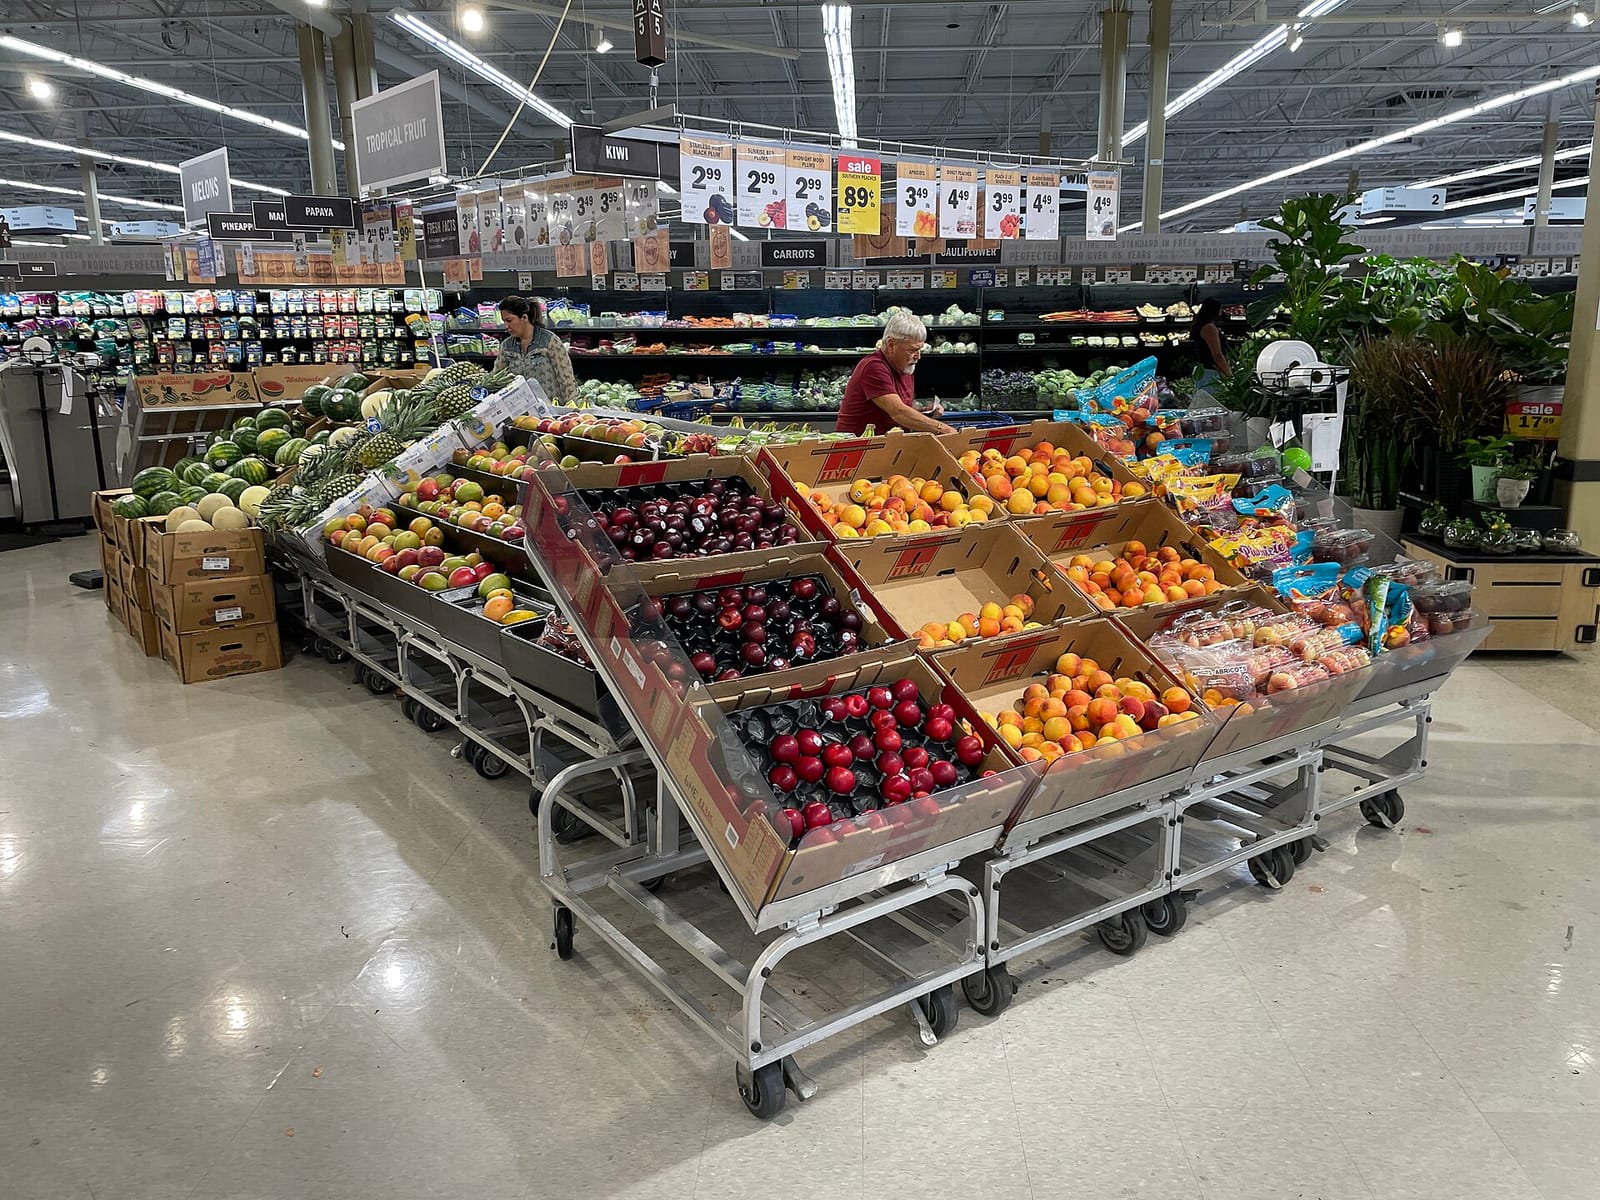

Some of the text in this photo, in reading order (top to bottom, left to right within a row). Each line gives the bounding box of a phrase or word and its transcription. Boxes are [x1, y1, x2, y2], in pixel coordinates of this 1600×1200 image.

[638, 17, 645, 36] 5
[654, 17, 661, 36] 5
[366, 118, 428, 154] TROPICAL FRUIT
[605, 145, 629, 161] KIWI
[847, 161, 872, 173] sale
[1066, 173, 1088, 185] win
[191, 176, 220, 202] MELONS
[1432, 194, 1440, 205] 2
[305, 206, 334, 217] PAPAYA
[1354, 211, 1361, 219] 3
[221, 222, 253, 232] PINEAPP
[426, 218, 457, 235] FRESH FACTS
[773, 249, 815, 259] CARROTS
[1009, 251, 1058, 261] PERFECTED
[1195, 248, 1235, 258] PRODUCE
[82, 260, 164, 270] PRODUCE PERFECTE
[1522, 404, 1553, 414] sale
